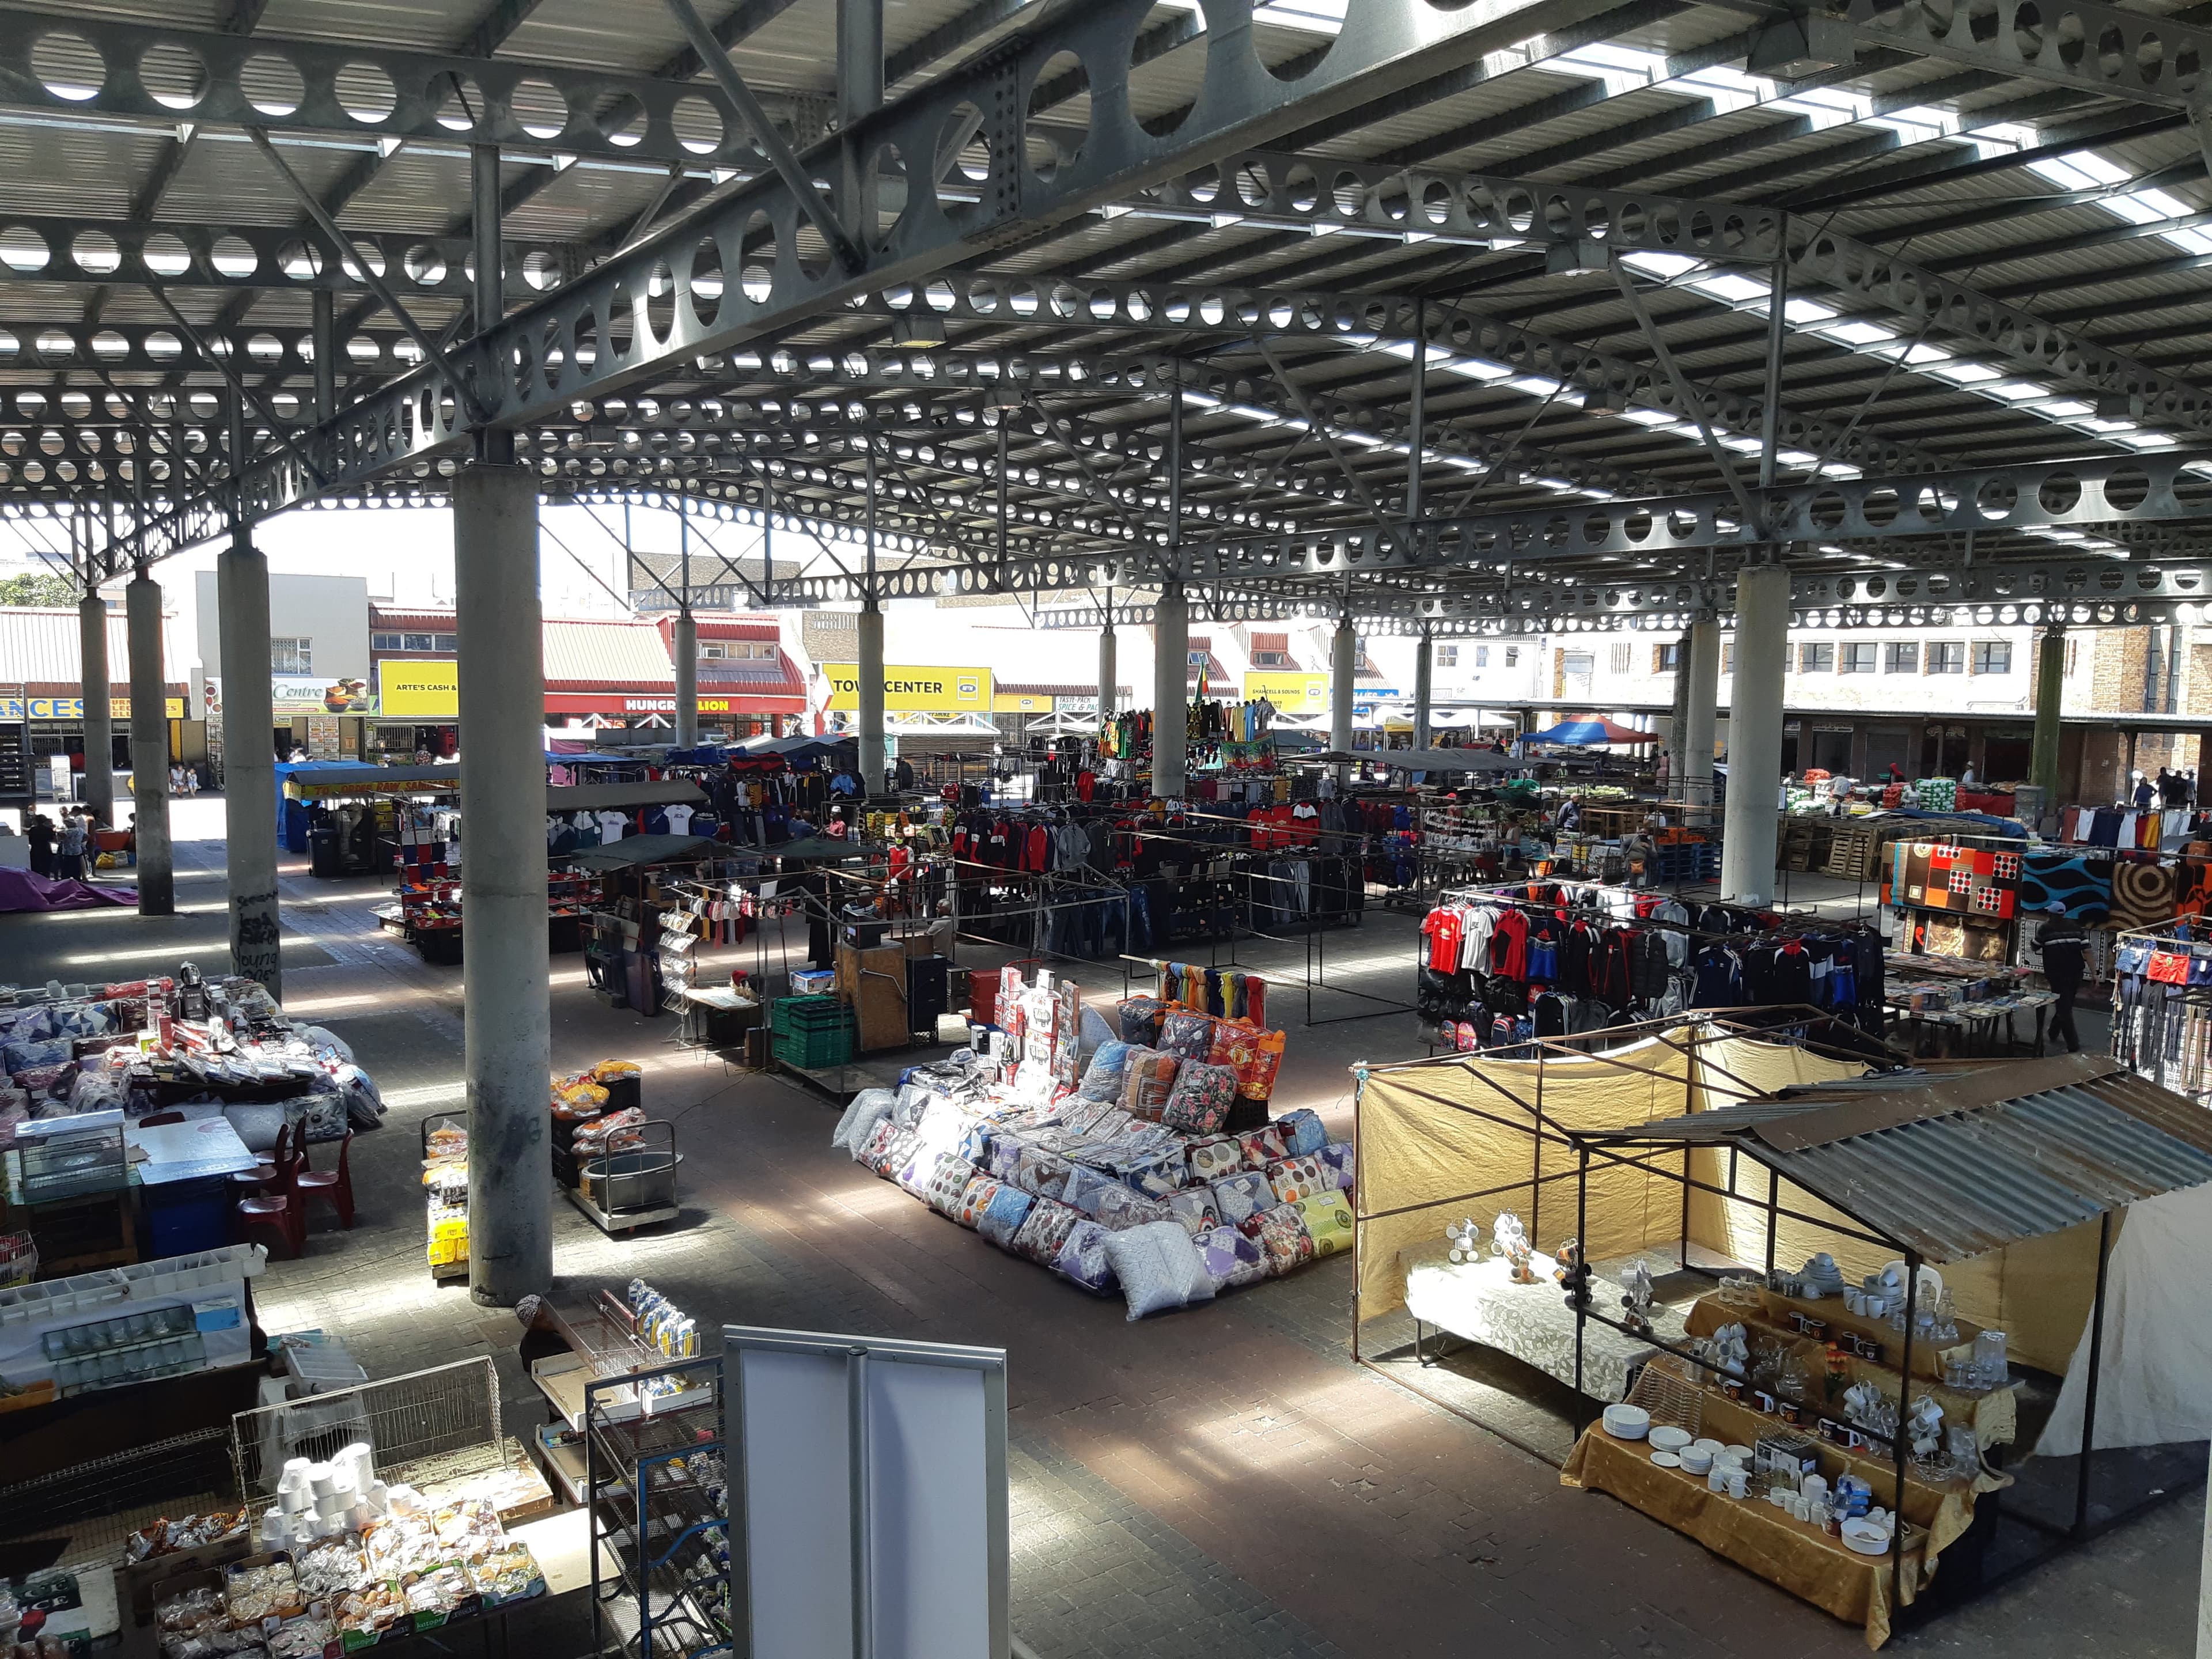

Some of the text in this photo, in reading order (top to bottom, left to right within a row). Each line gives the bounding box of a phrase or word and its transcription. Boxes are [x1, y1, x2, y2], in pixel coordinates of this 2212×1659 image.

[273, 684, 324, 699] Centre
[833, 680, 942, 694] TO CENTER
[626, 700, 729, 711] HUNGR LION
[376, 782, 399, 791] RAW
